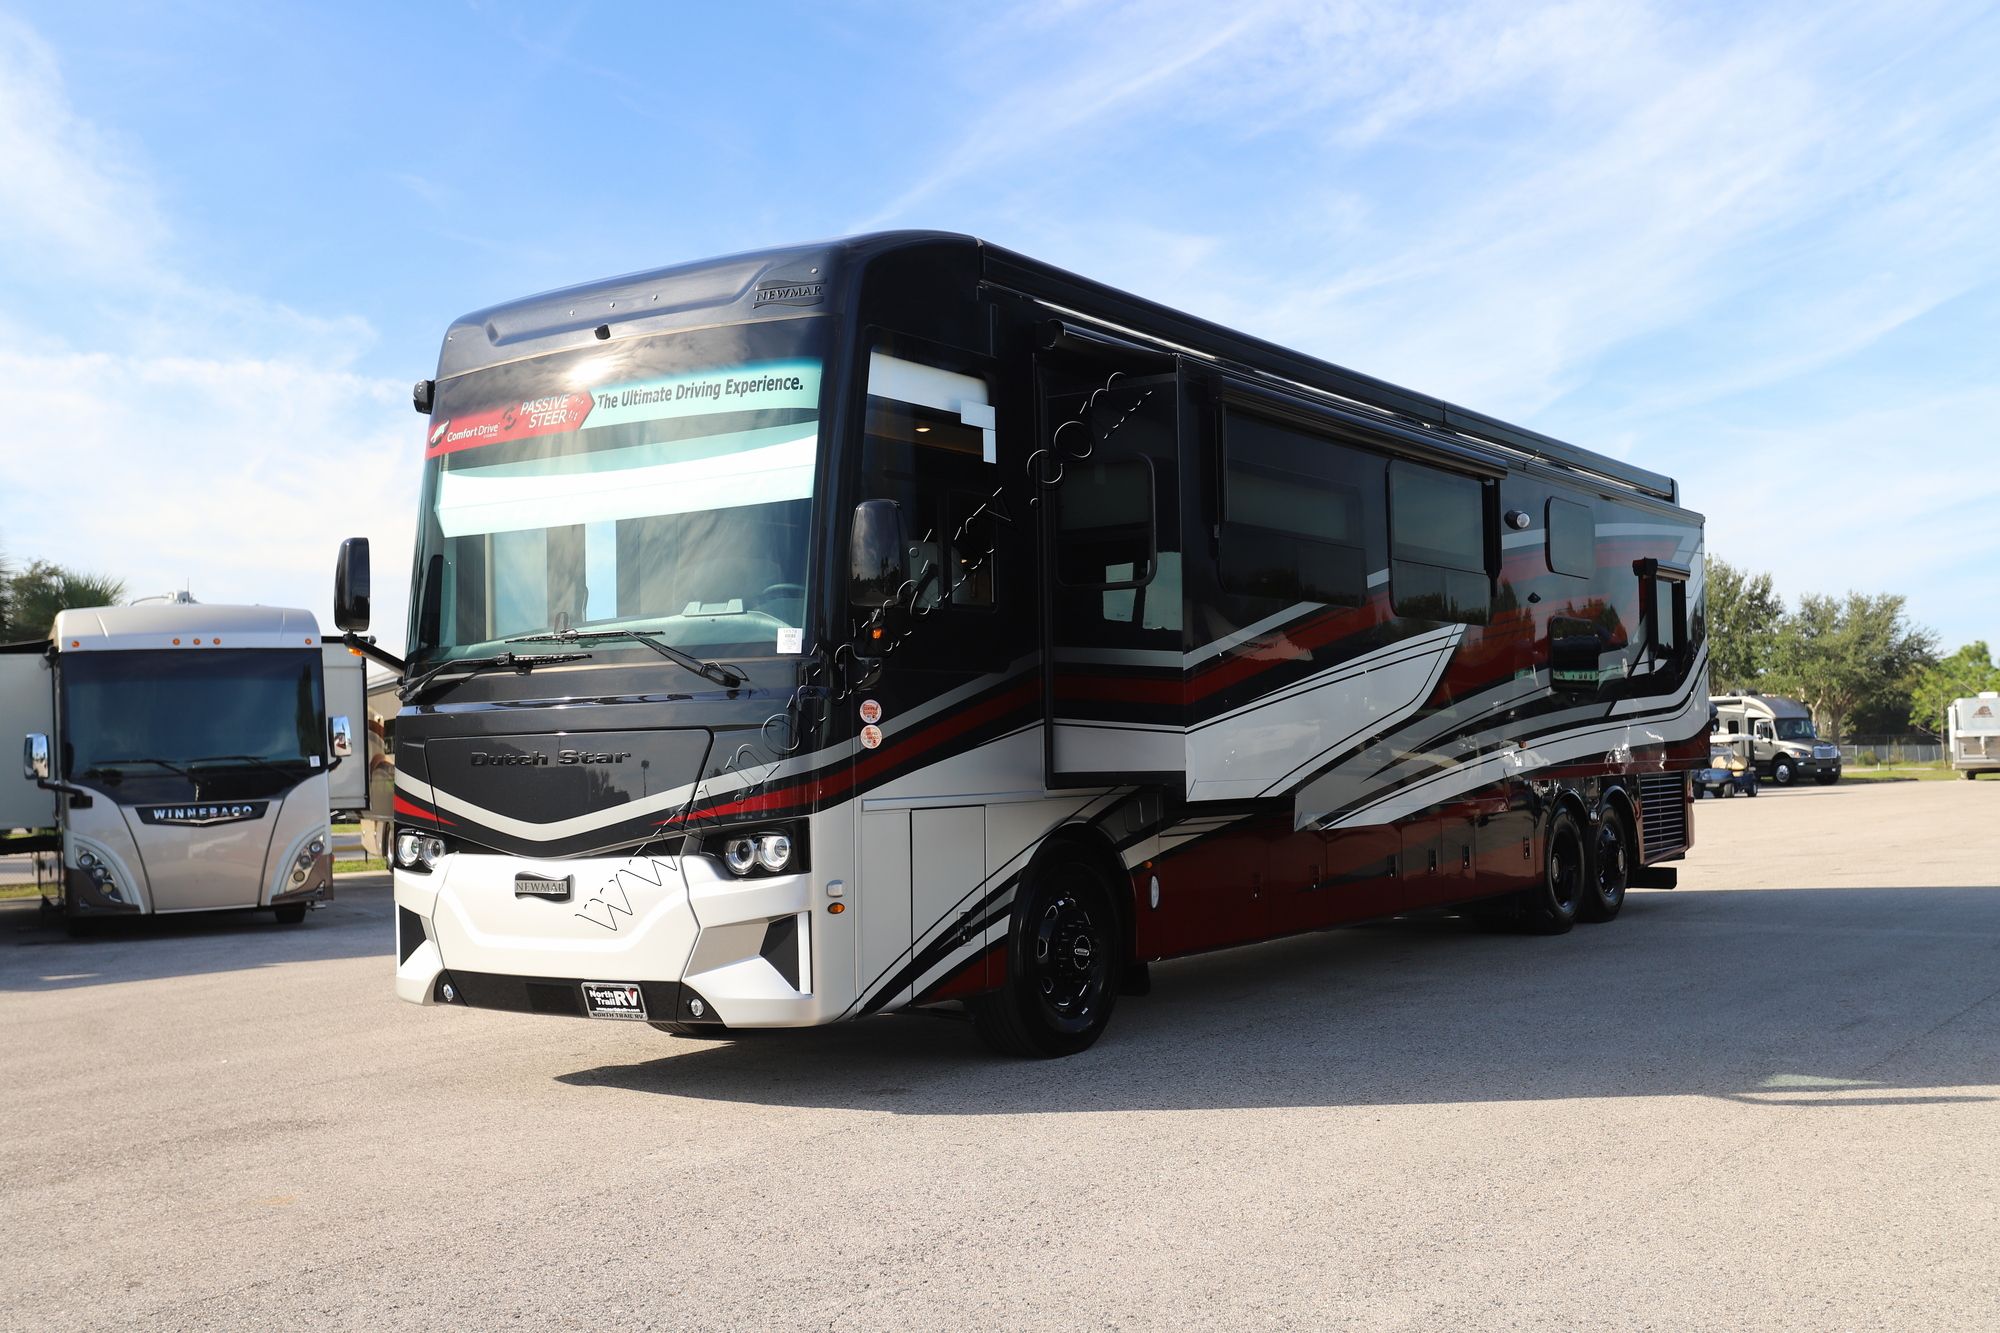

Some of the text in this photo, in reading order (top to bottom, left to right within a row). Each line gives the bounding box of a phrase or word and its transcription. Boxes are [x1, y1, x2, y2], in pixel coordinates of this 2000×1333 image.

[755, 285, 824, 301] NEWMAR
[597, 374, 804, 410] The Ultimate Driving Experience.
[519, 393, 571, 416] PASSIVE
[528, 408, 568, 429] STEER
[446, 427, 478, 443] Comfort
[478, 423, 499, 436] Drive
[470, 749, 632, 767] Dutch Star
[153, 805, 253, 820] WINNEBAGO
[515, 882, 565, 893] NEWMAR
[589, 990, 613, 998] North
[595, 990, 638, 1006] Trail RV
